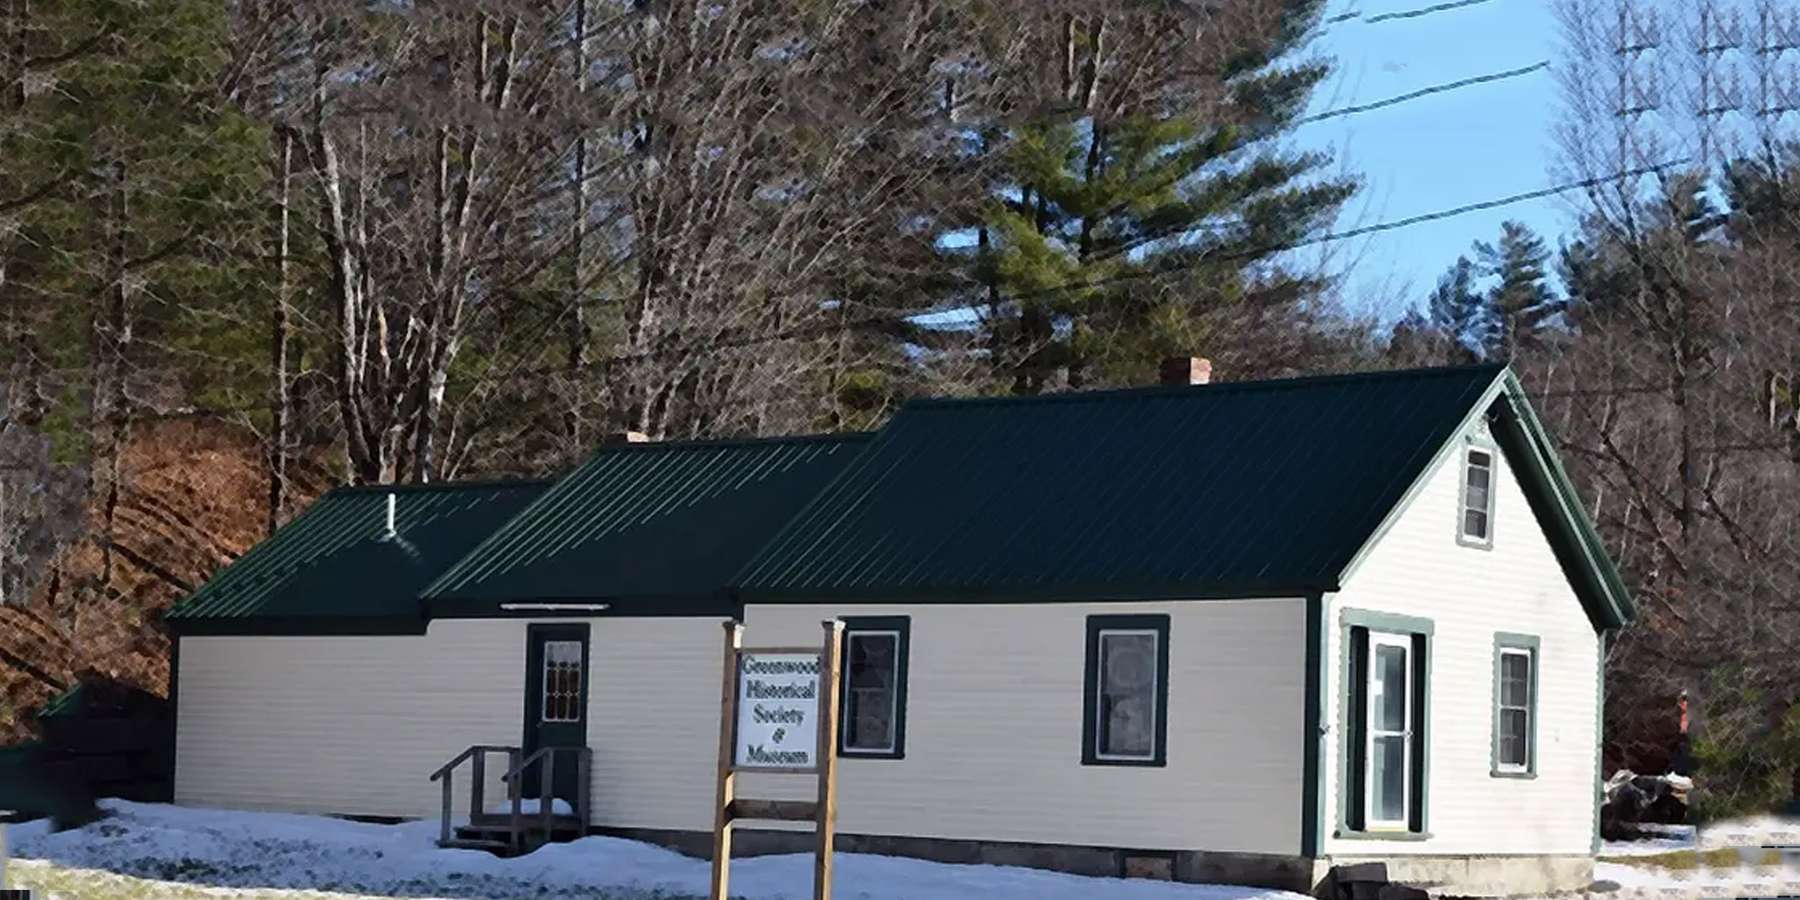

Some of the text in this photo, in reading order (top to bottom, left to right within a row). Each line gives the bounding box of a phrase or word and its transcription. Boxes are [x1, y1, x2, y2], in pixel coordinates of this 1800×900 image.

[742, 655, 821, 674] Greenwood
[746, 680, 815, 699] Historical
[752, 704, 805, 726] Society
[746, 744, 809, 763] Museum
